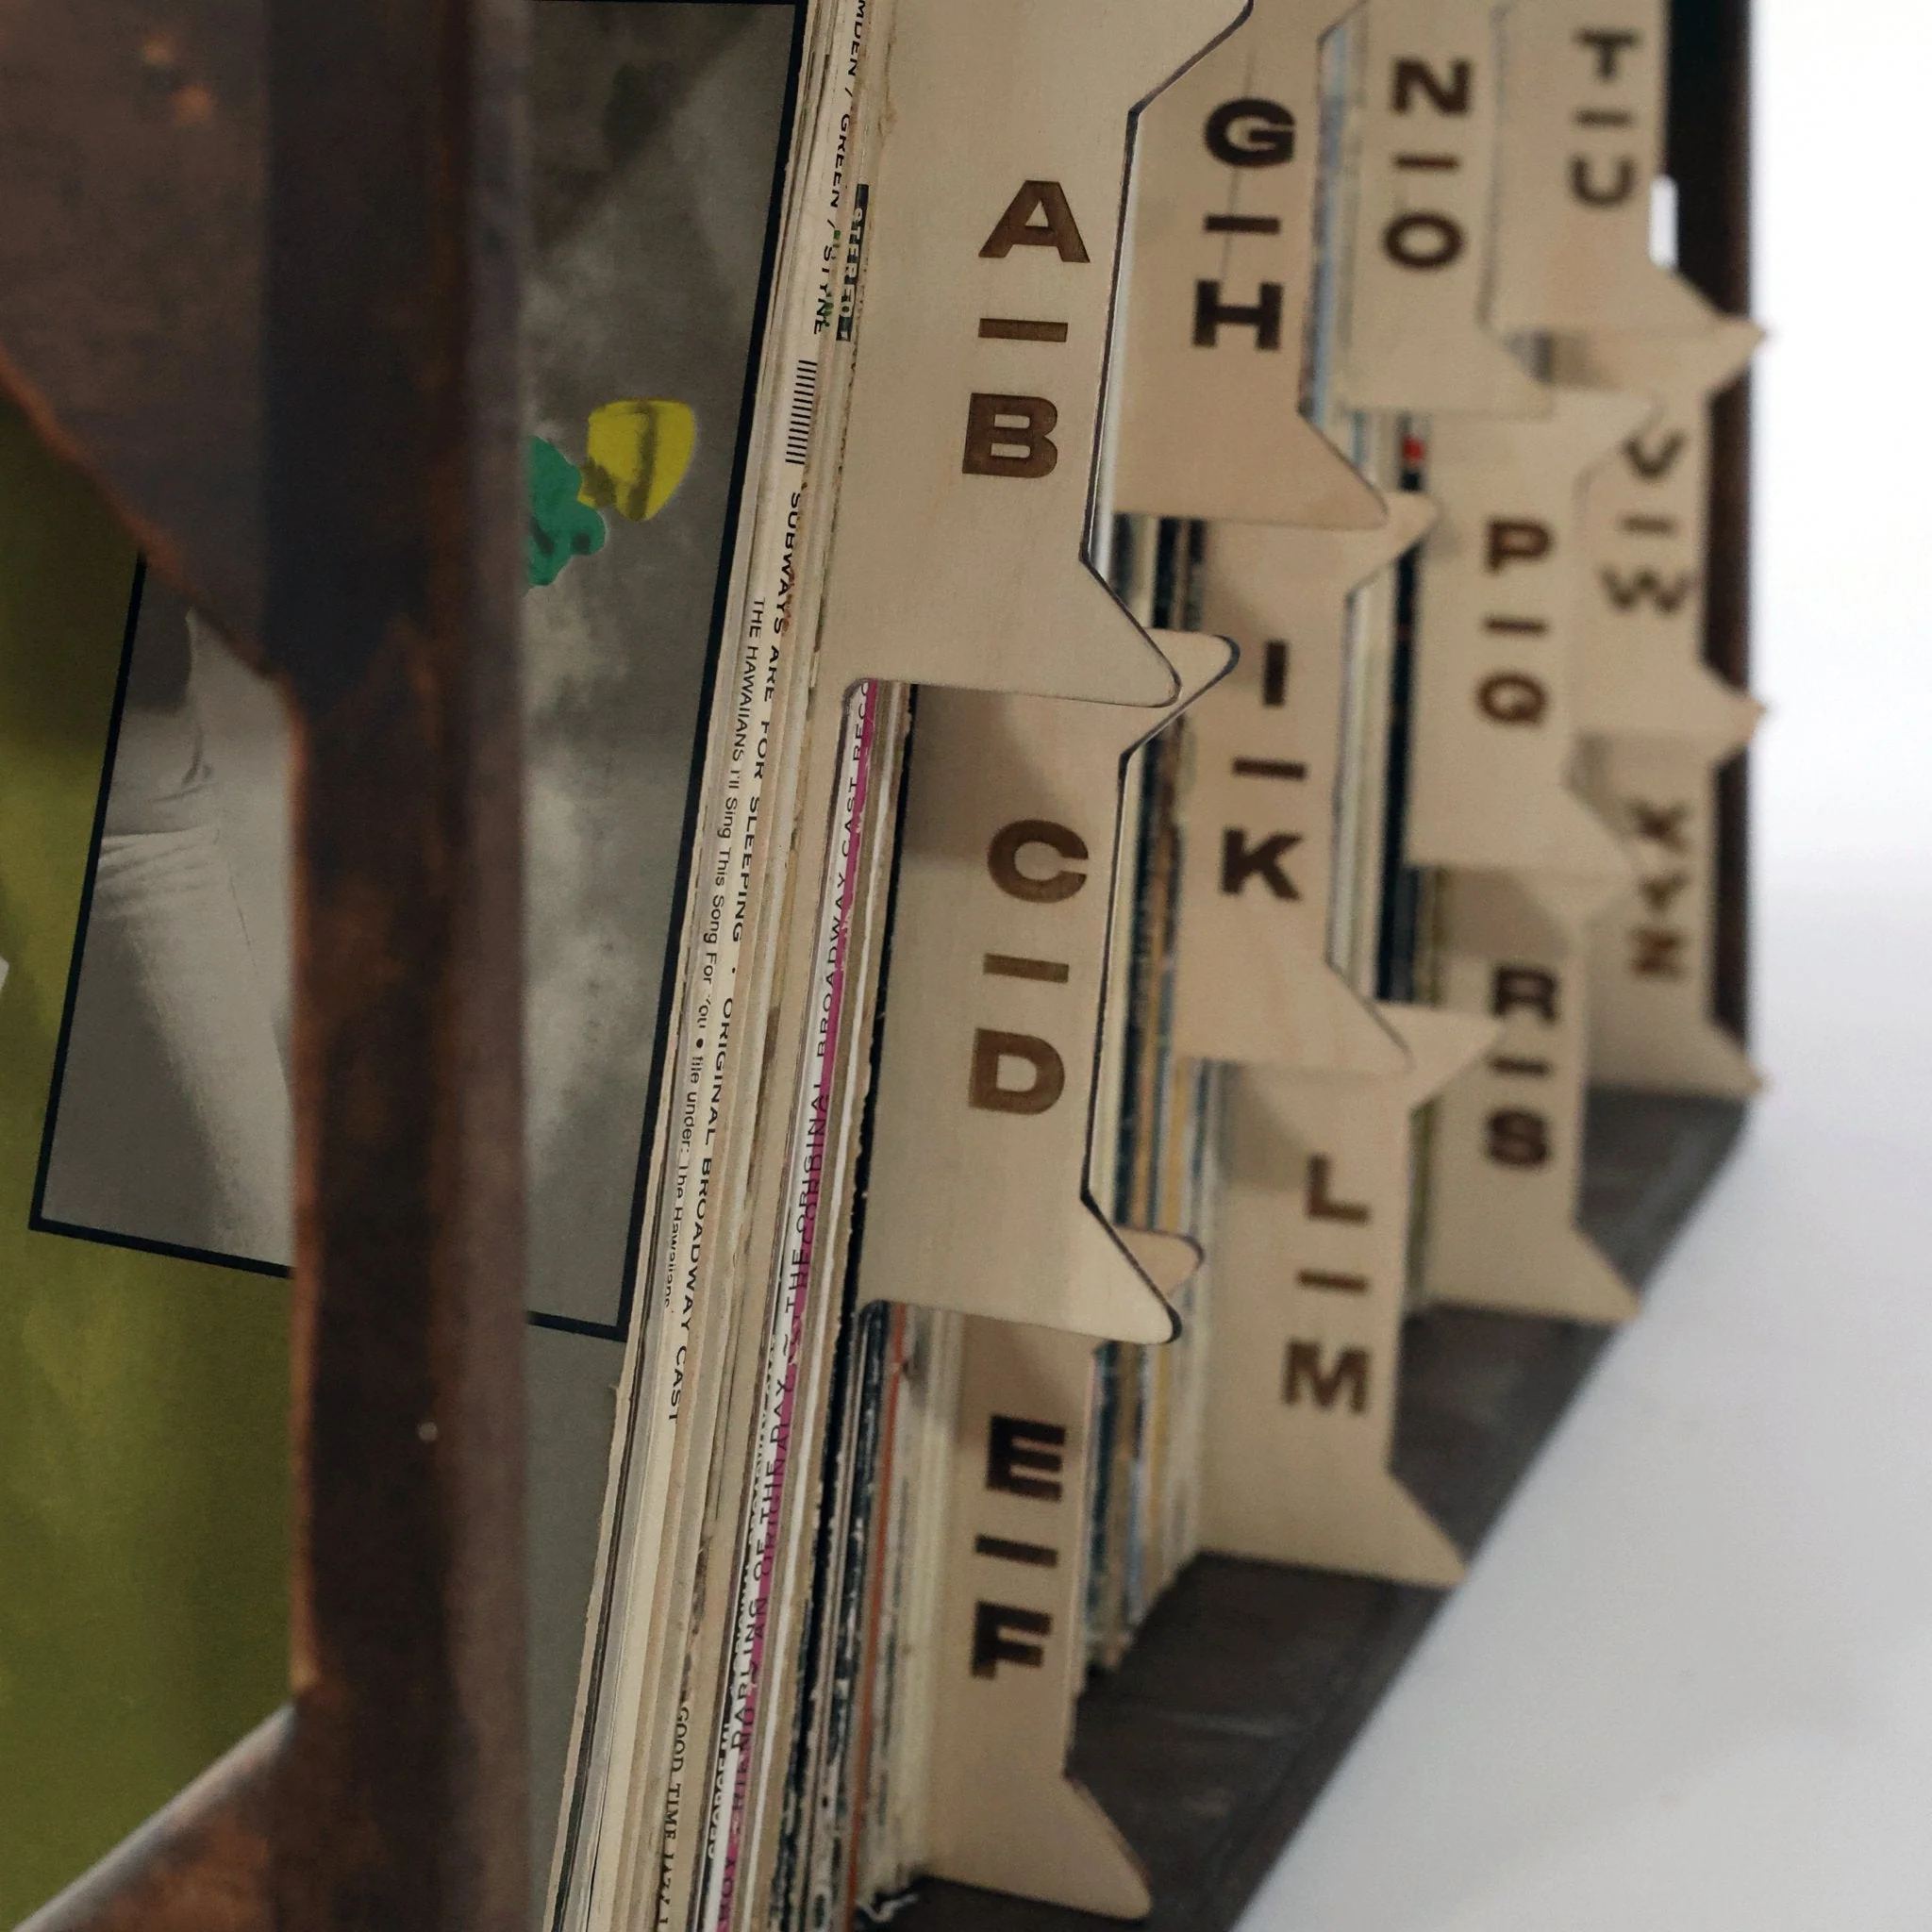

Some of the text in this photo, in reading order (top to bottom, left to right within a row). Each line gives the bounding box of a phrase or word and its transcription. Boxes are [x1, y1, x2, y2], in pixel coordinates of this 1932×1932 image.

[1391, 56, 1472, 117] N
[829, 113, 849, 207] GREEN
[1205, 98, 1296, 168] G
[978, 179, 1091, 263] A
[1192, 279, 1283, 352] H
[962, 392, 1058, 478] B
[748, 600, 764, 639] THE
[731, 645, 758, 761] HAWAIIANS
[716, 796, 737, 840] Sing
[714, 850, 730, 888] This
[987, 819, 1089, 904] C
[1221, 825, 1305, 903] K
[702, 893, 724, 944] Song
[667, 491, 801, 1424] SUBWAYS ARE FOR SLEEPING ORIGINAL BROADWAY CAST
[702, 951, 716, 984] For
[785, 1248, 801, 1313] THE
[816, 871, 846, 1058] BROADWAY
[841, 776, 858, 857] CAST
[968, 1027, 1065, 1115] D
[679, 1091, 699, 1154] under:
[1307, 1151, 1371, 1225] L
[1281, 1338, 1370, 1412] M
[986, 1413, 1067, 1503] E
[969, 1600, 1054, 1680] F
[671, 1706, 690, 1774] GOOD
[663, 1782, 681, 1840] TIME
